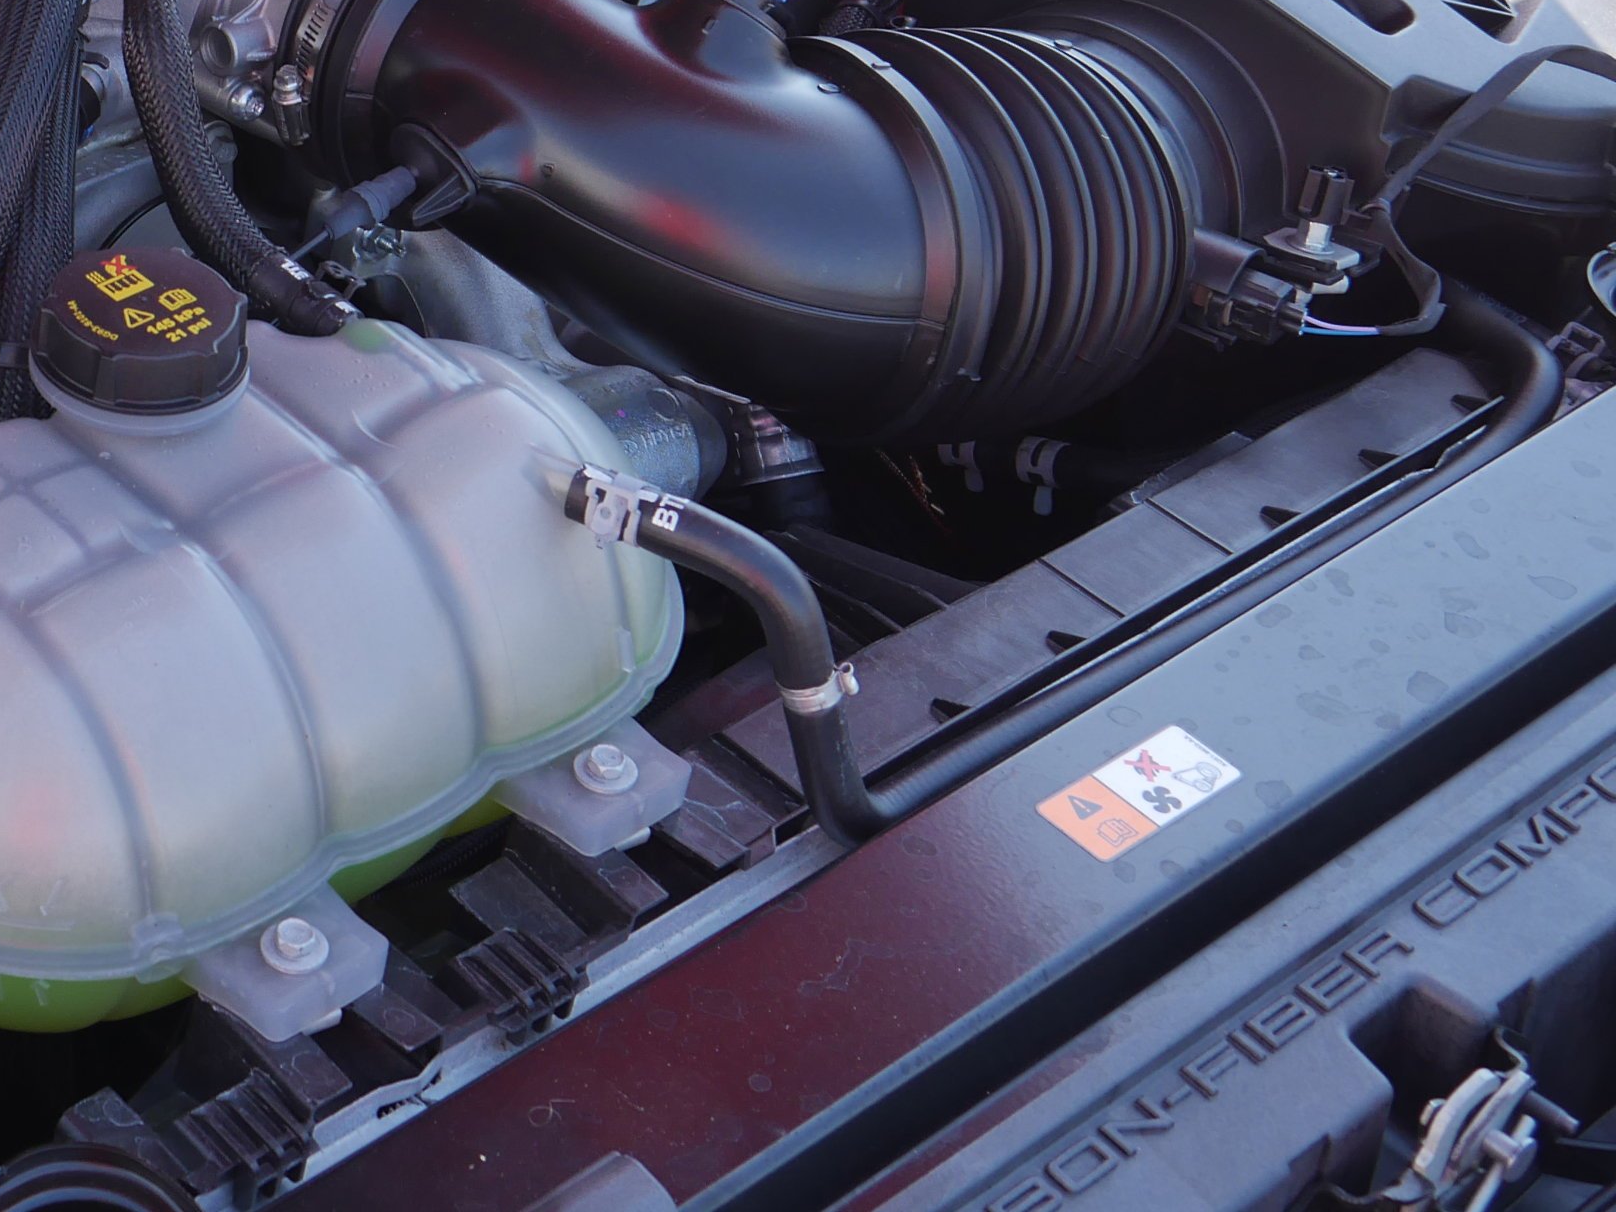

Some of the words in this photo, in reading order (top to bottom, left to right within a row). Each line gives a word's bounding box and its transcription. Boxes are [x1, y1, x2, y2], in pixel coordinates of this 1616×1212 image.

[146, 318, 175, 335] 145
[173, 307, 205, 323] kPa
[165, 329, 187, 342] 21
